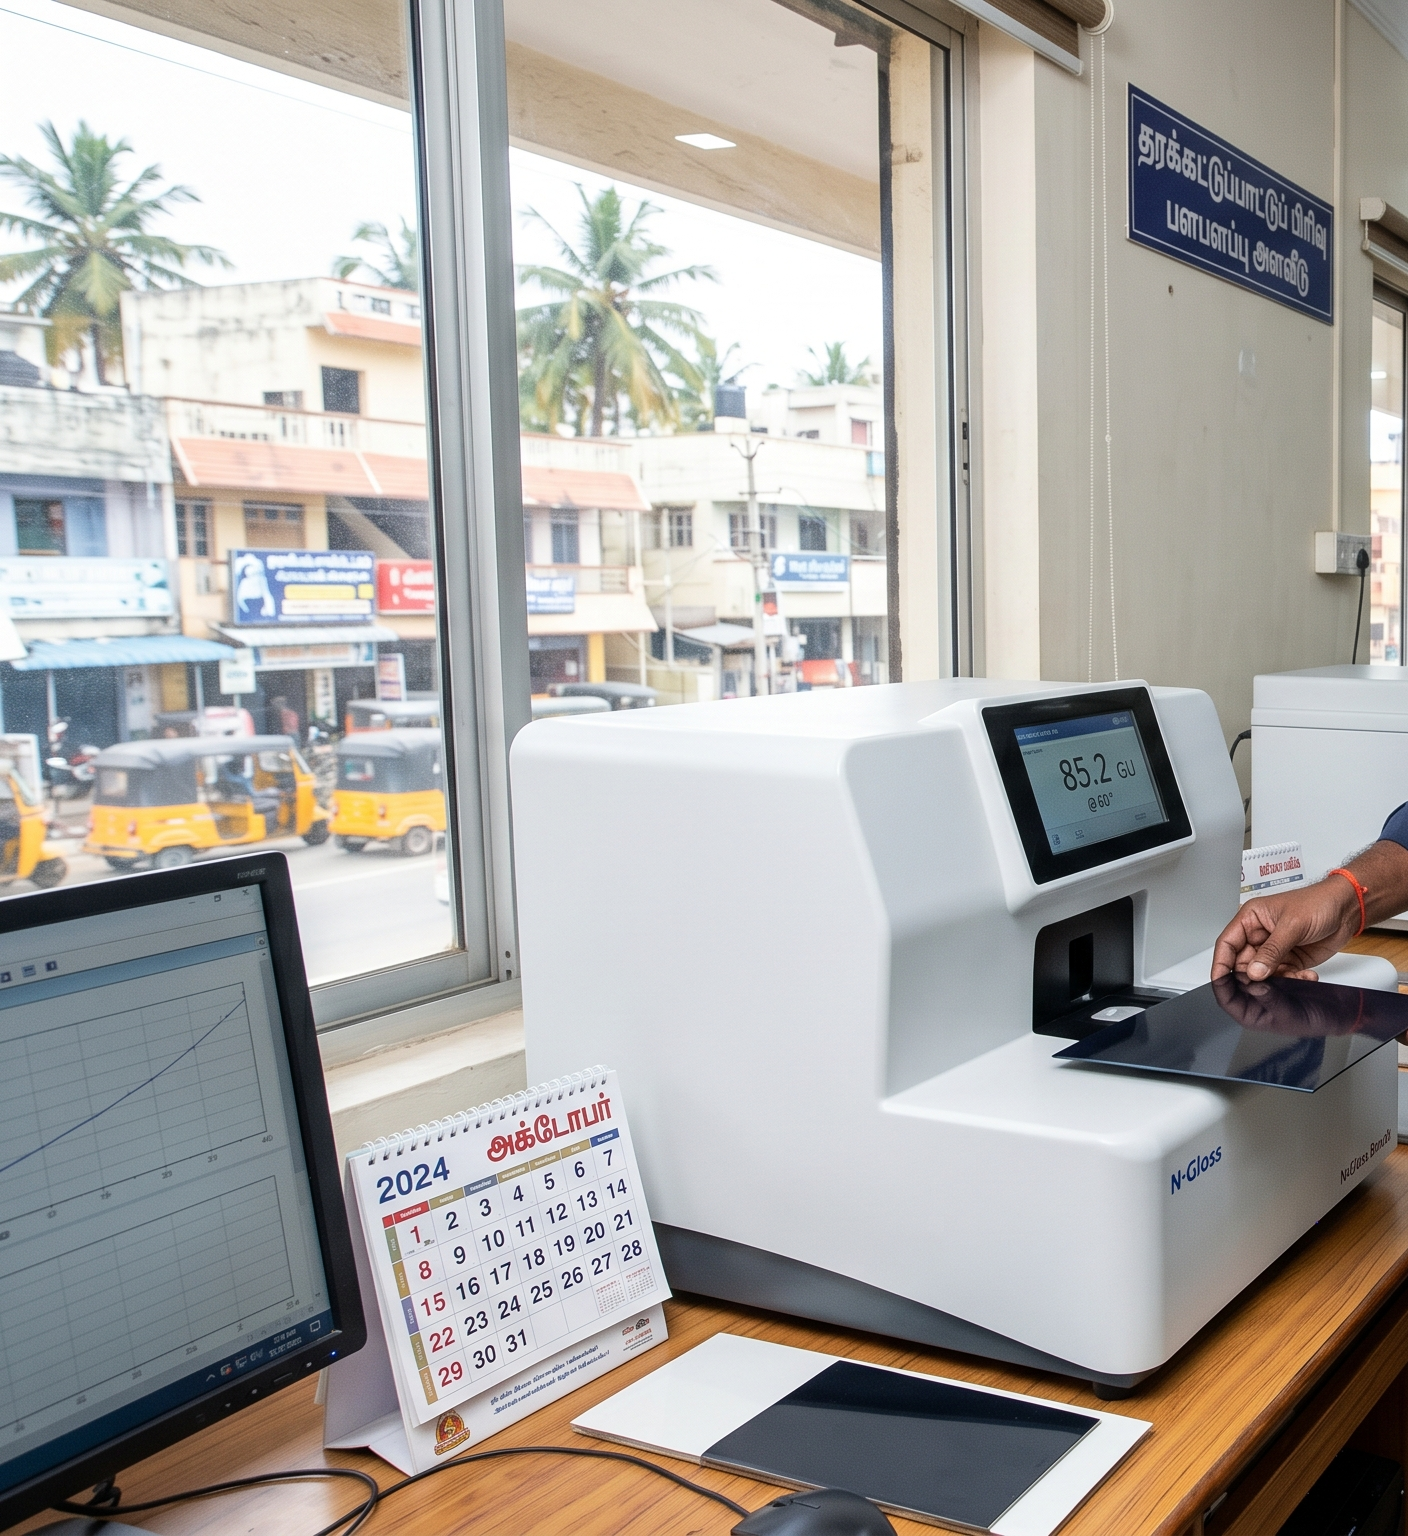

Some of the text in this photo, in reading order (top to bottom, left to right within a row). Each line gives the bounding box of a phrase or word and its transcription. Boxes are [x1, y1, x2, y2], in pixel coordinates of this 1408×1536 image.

[1138, 122, 1327, 261] தரக்கட்டுப்பாட்டுப் பிரிவு
[1166, 199, 1310, 297] பளபளப்பு அளவீடு
[1059, 753, 1136, 791] 85.2 GU
[486, 1091, 612, 1163] அக்டோபர்
[1171, 1145, 1223, 1196] N-Gloss
[376, 1156, 450, 1205] 2024
[410, 1225, 421, 1244] 1
[445, 1211, 459, 1231] 2
[479, 1198, 492, 1217] 3
[512, 1184, 525, 1203] 4
[544, 1171, 556, 1191] 5
[574, 1160, 586, 1178] 6
[602, 1148, 614, 1167] 7
[418, 1178, 627, 1280] 8 9 10 11 12 13 14
[420, 1209, 634, 1317] 15 16 17 18 19 20 21
[429, 1239, 643, 1353] 22 23 24 25 26 27 28
[438, 1328, 527, 1388] 29 30 31
